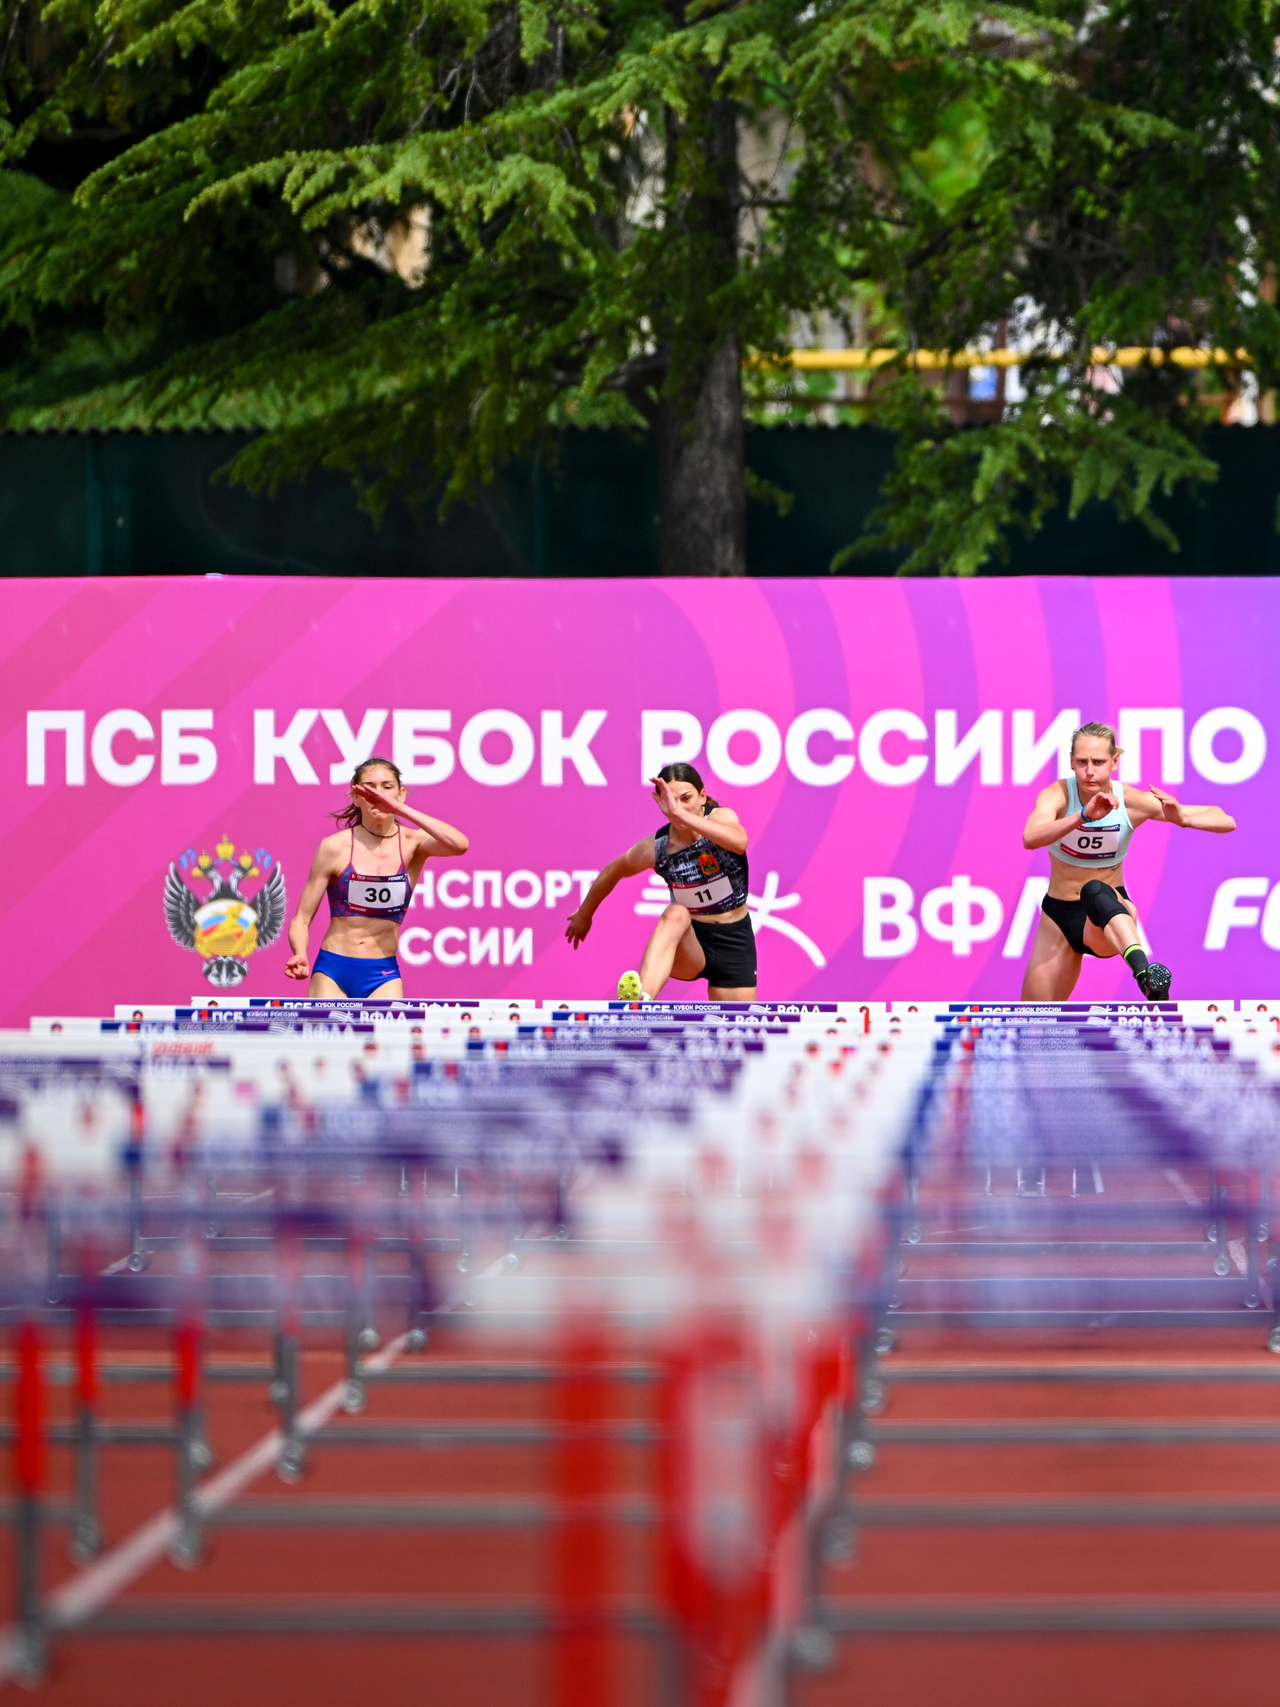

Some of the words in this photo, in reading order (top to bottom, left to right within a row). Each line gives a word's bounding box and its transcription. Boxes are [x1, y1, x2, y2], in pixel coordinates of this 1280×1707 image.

[26, 709, 218, 786] ПСБ
[253, 709, 608, 787] КУБОК
[641, 708, 1081, 786] РОССИИ
[1119, 706, 1268, 785] ПО
[1077, 836, 1104, 849] 05
[364, 887, 391, 903] 30
[410, 869, 602, 909] НСПОРТ
[694, 888, 712, 903] 11
[398, 926, 534, 966] ССИИ
[211, 1011, 244, 1023] ПСБ
